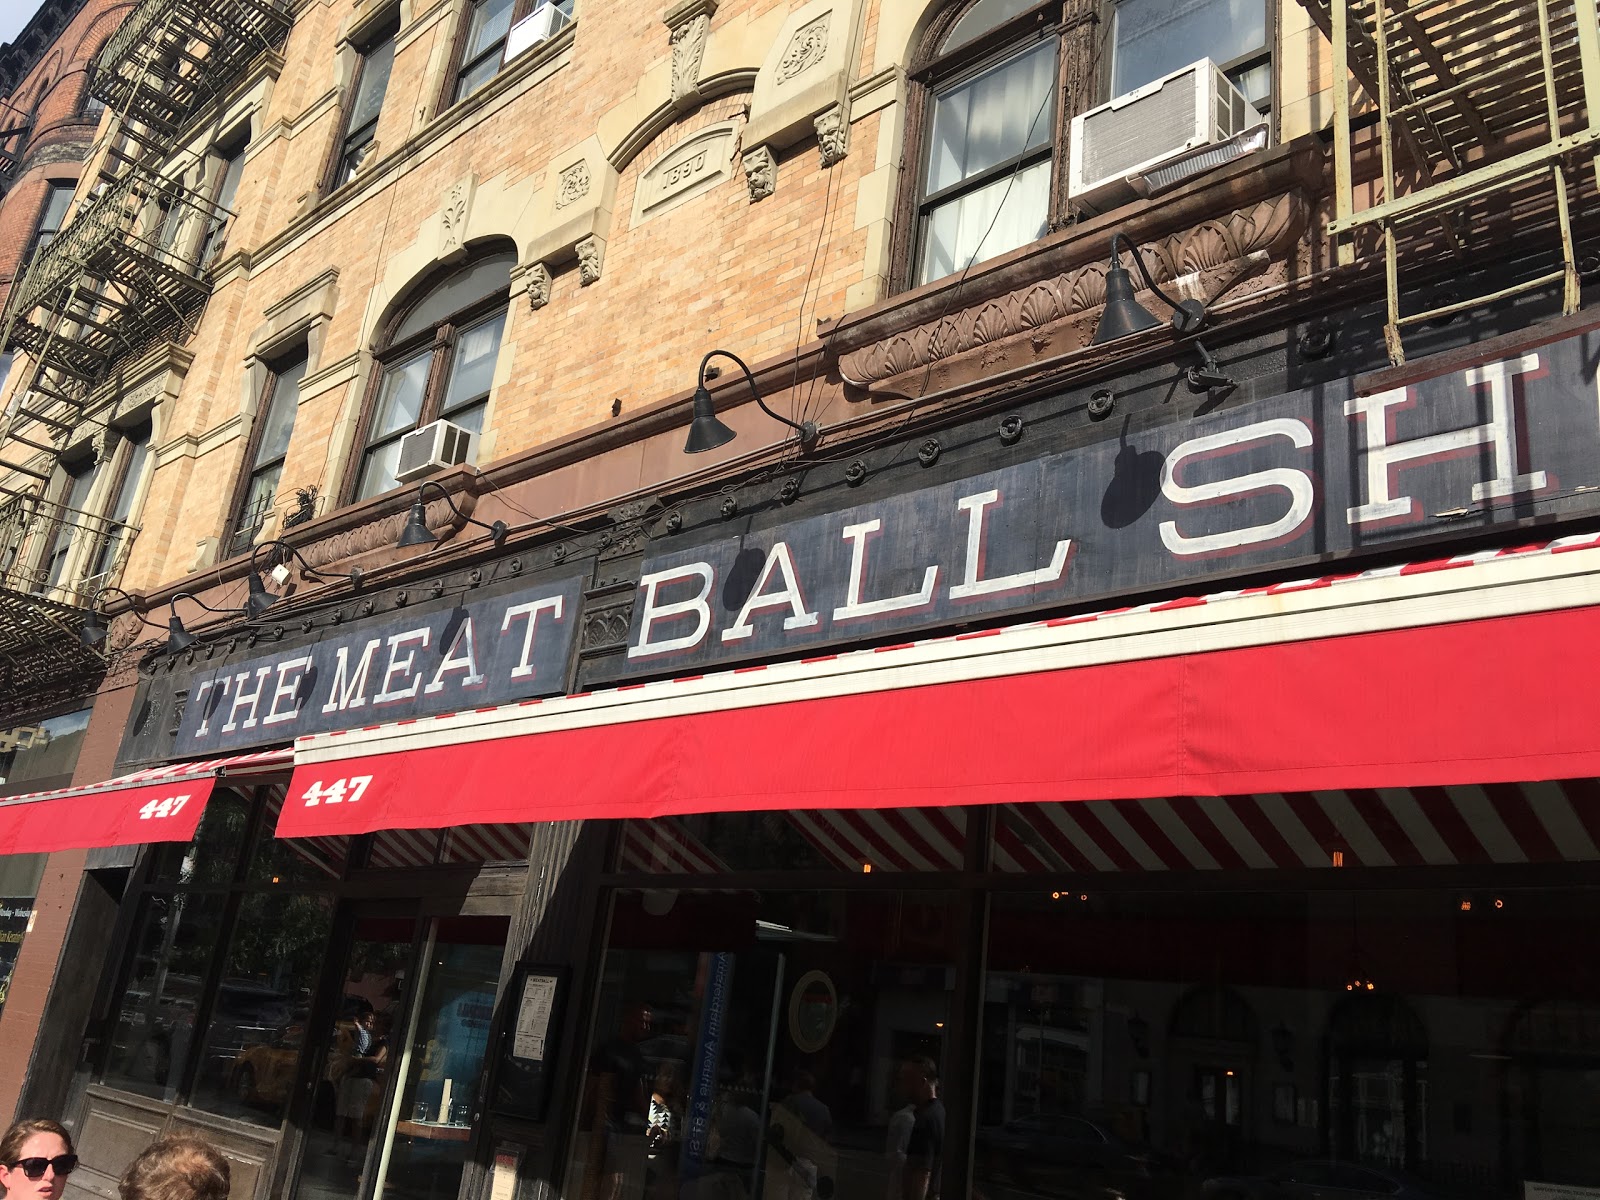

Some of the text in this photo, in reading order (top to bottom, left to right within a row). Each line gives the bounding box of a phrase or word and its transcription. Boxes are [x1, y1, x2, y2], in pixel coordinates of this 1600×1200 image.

[662, 152, 707, 190] 1890
[195, 352, 1600, 739] THE MEAT BALL SH
[139, 794, 192, 820] 447
[301, 775, 373, 808] 447
